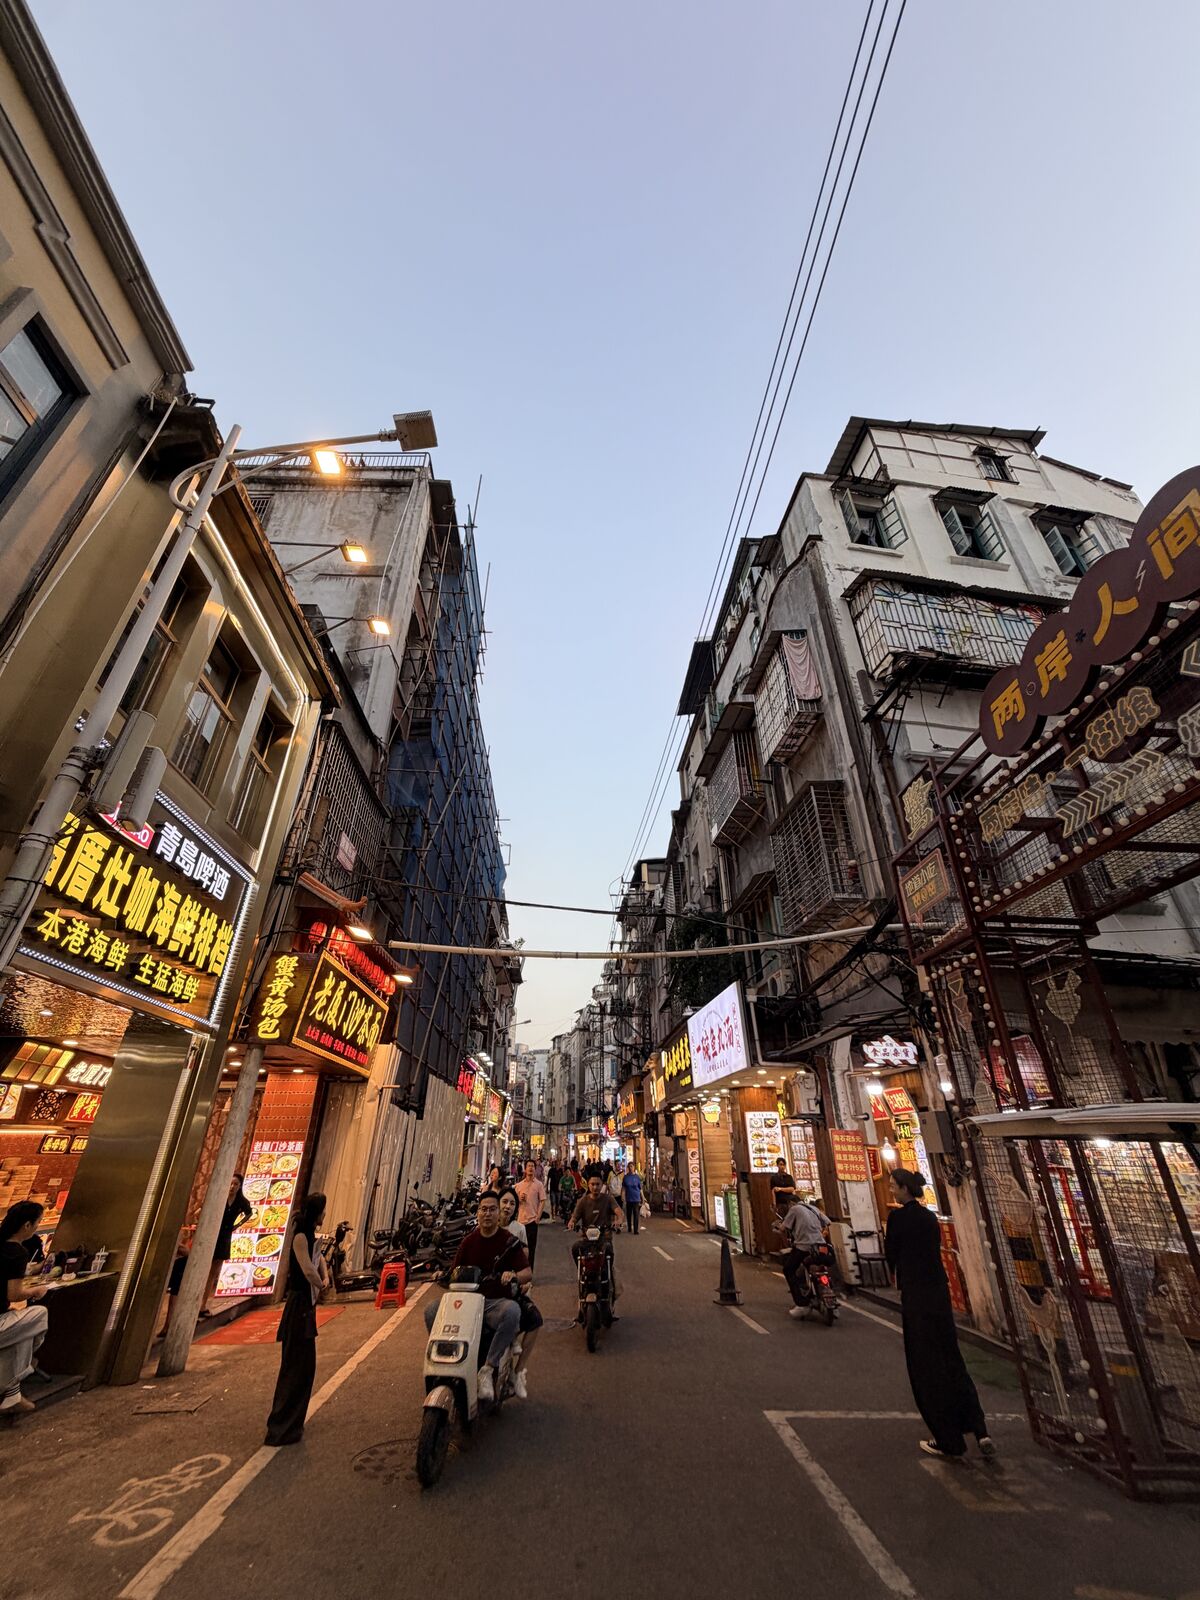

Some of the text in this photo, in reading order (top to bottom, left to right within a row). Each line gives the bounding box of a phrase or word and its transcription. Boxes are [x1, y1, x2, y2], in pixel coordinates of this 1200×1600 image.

[155, 821, 231, 901] 青岛啤酒
[36, 908, 200, 1003] 本港海鲜 生猛海鲜
[257, 954, 299, 1039] 蟹黄汤包
[308, 970, 382, 1052] 老厦门沙茶面
[70, 1094, 101, 1119] 蟹黄
